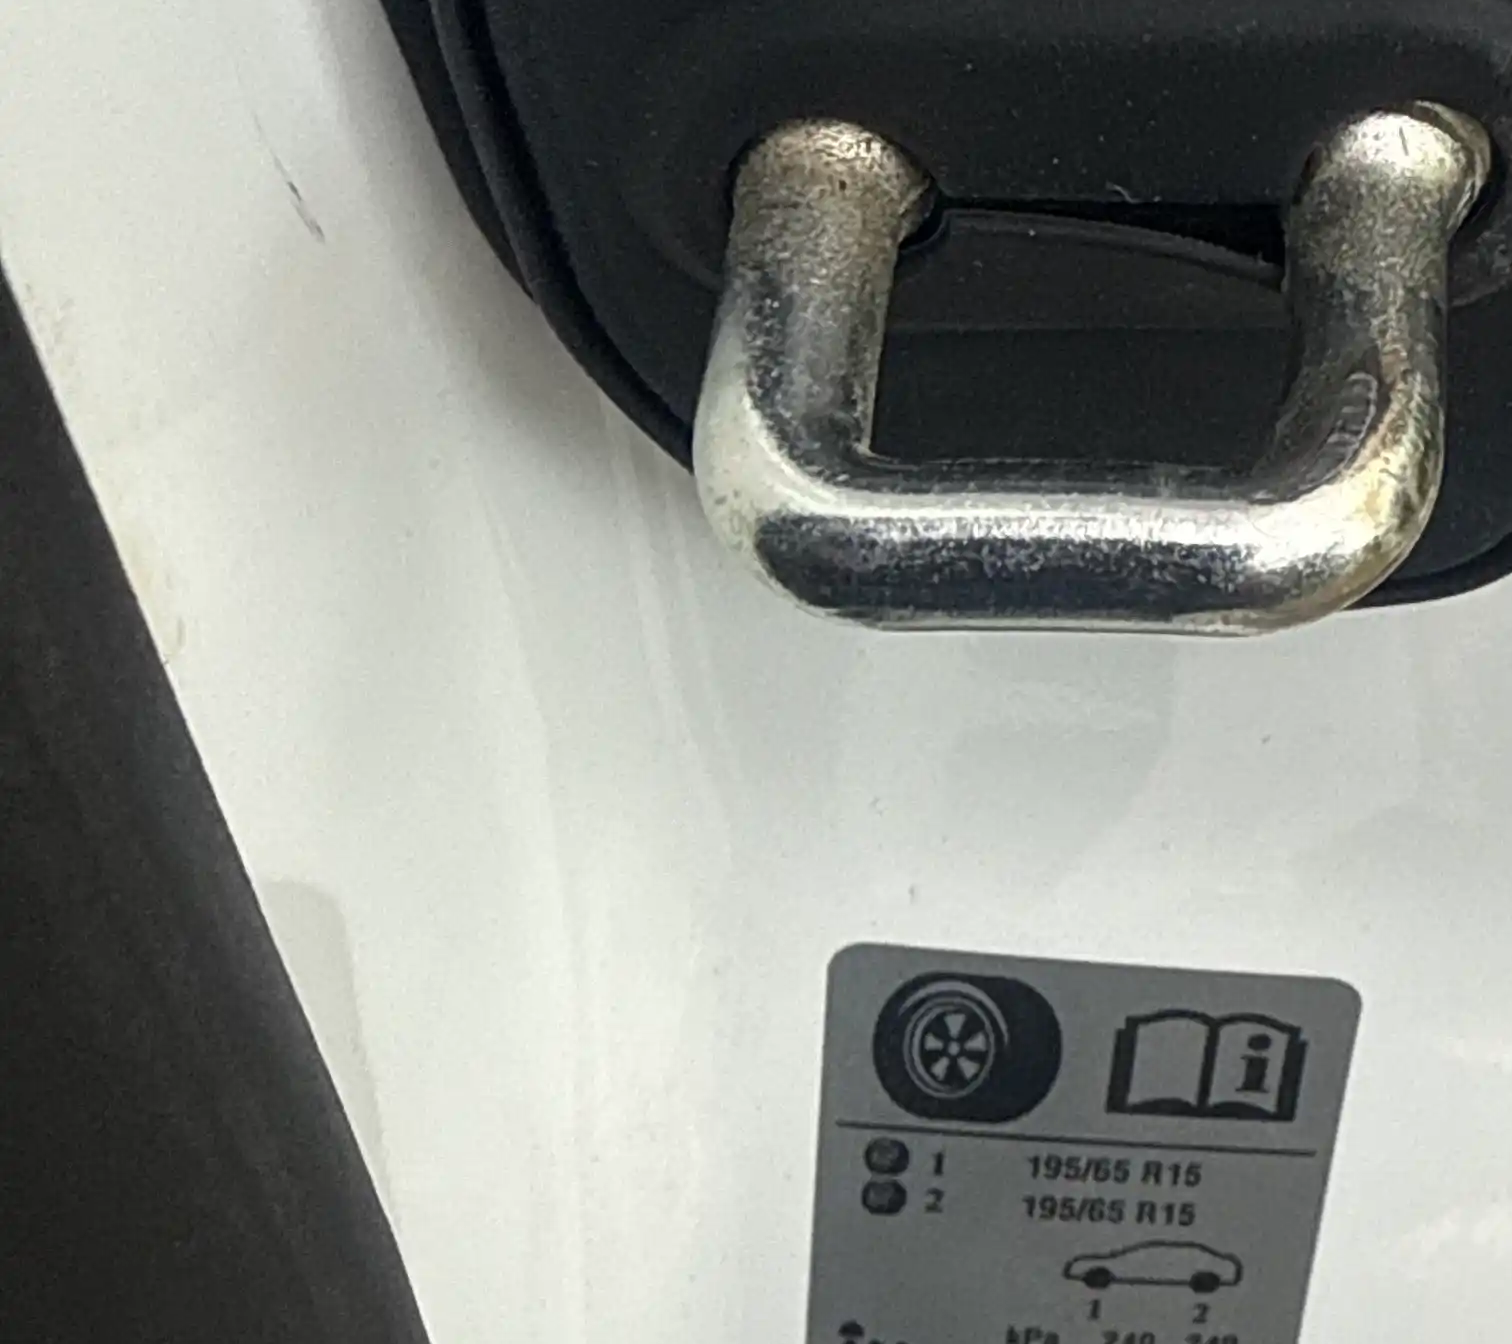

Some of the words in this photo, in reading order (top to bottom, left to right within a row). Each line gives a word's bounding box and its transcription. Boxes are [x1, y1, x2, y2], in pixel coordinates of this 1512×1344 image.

[933, 1151, 945, 1177] 1
[1027, 1153, 1130, 1184] 195/65
[1140, 1160, 1202, 1188] R15
[924, 1187, 945, 1214] 2
[1021, 1195, 1125, 1225] 195/65
[1135, 1200, 1196, 1227] R15
[1088, 1298, 1101, 1321] 1
[1191, 1302, 1211, 1325] 2
